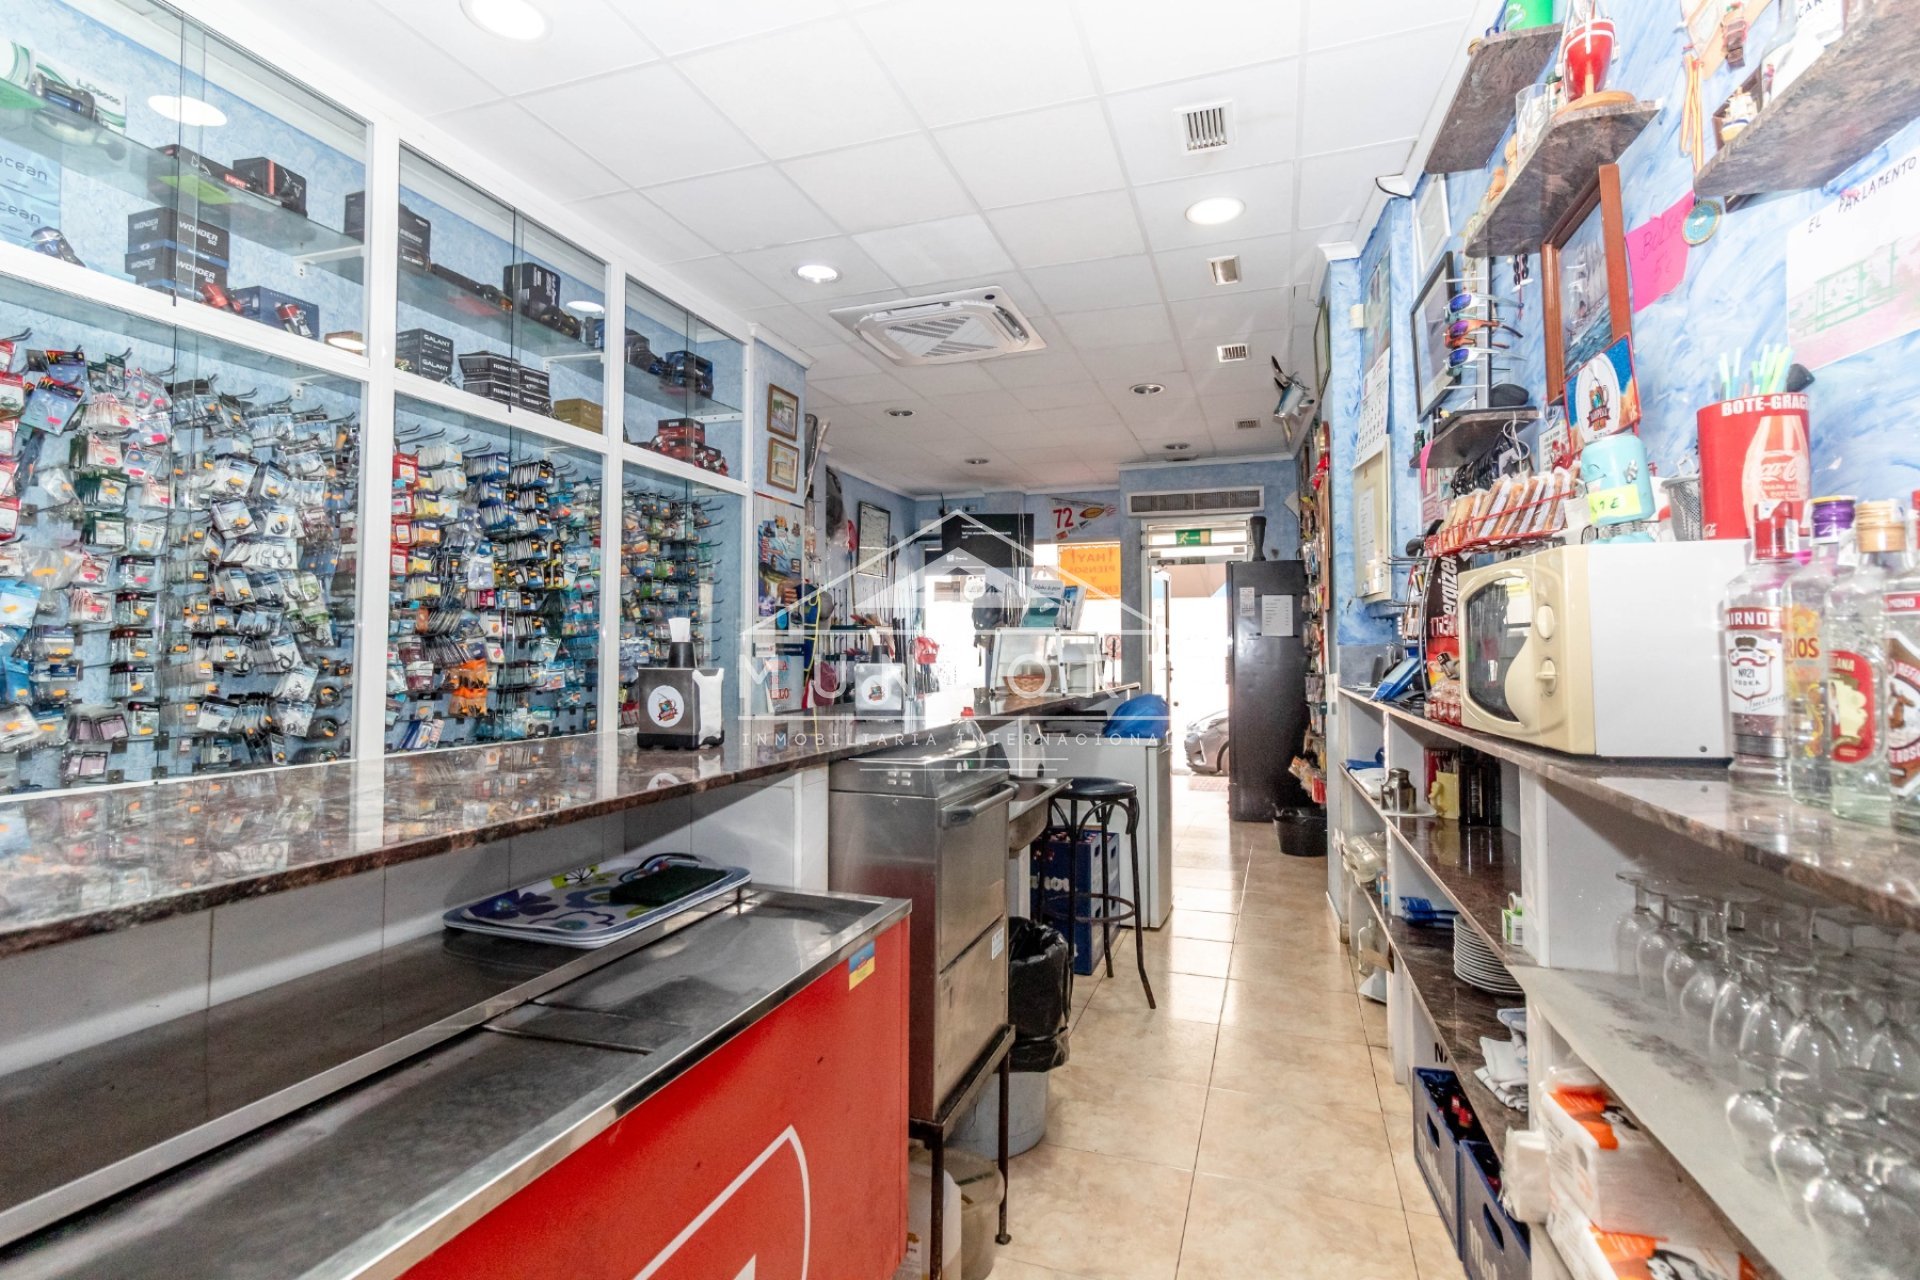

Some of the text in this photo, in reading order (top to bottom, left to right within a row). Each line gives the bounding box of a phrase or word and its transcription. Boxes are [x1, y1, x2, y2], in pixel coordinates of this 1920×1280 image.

[0, 156, 47, 181] cean
[1808, 156, 1917, 234] EL PARLAMENTO
[179, 220, 219, 242] WONDER
[177, 260, 216, 280] WONDER
[423, 334, 451, 348] GALANT
[422, 358, 449, 372] GALANT
[1053, 507, 1074, 529] 72
